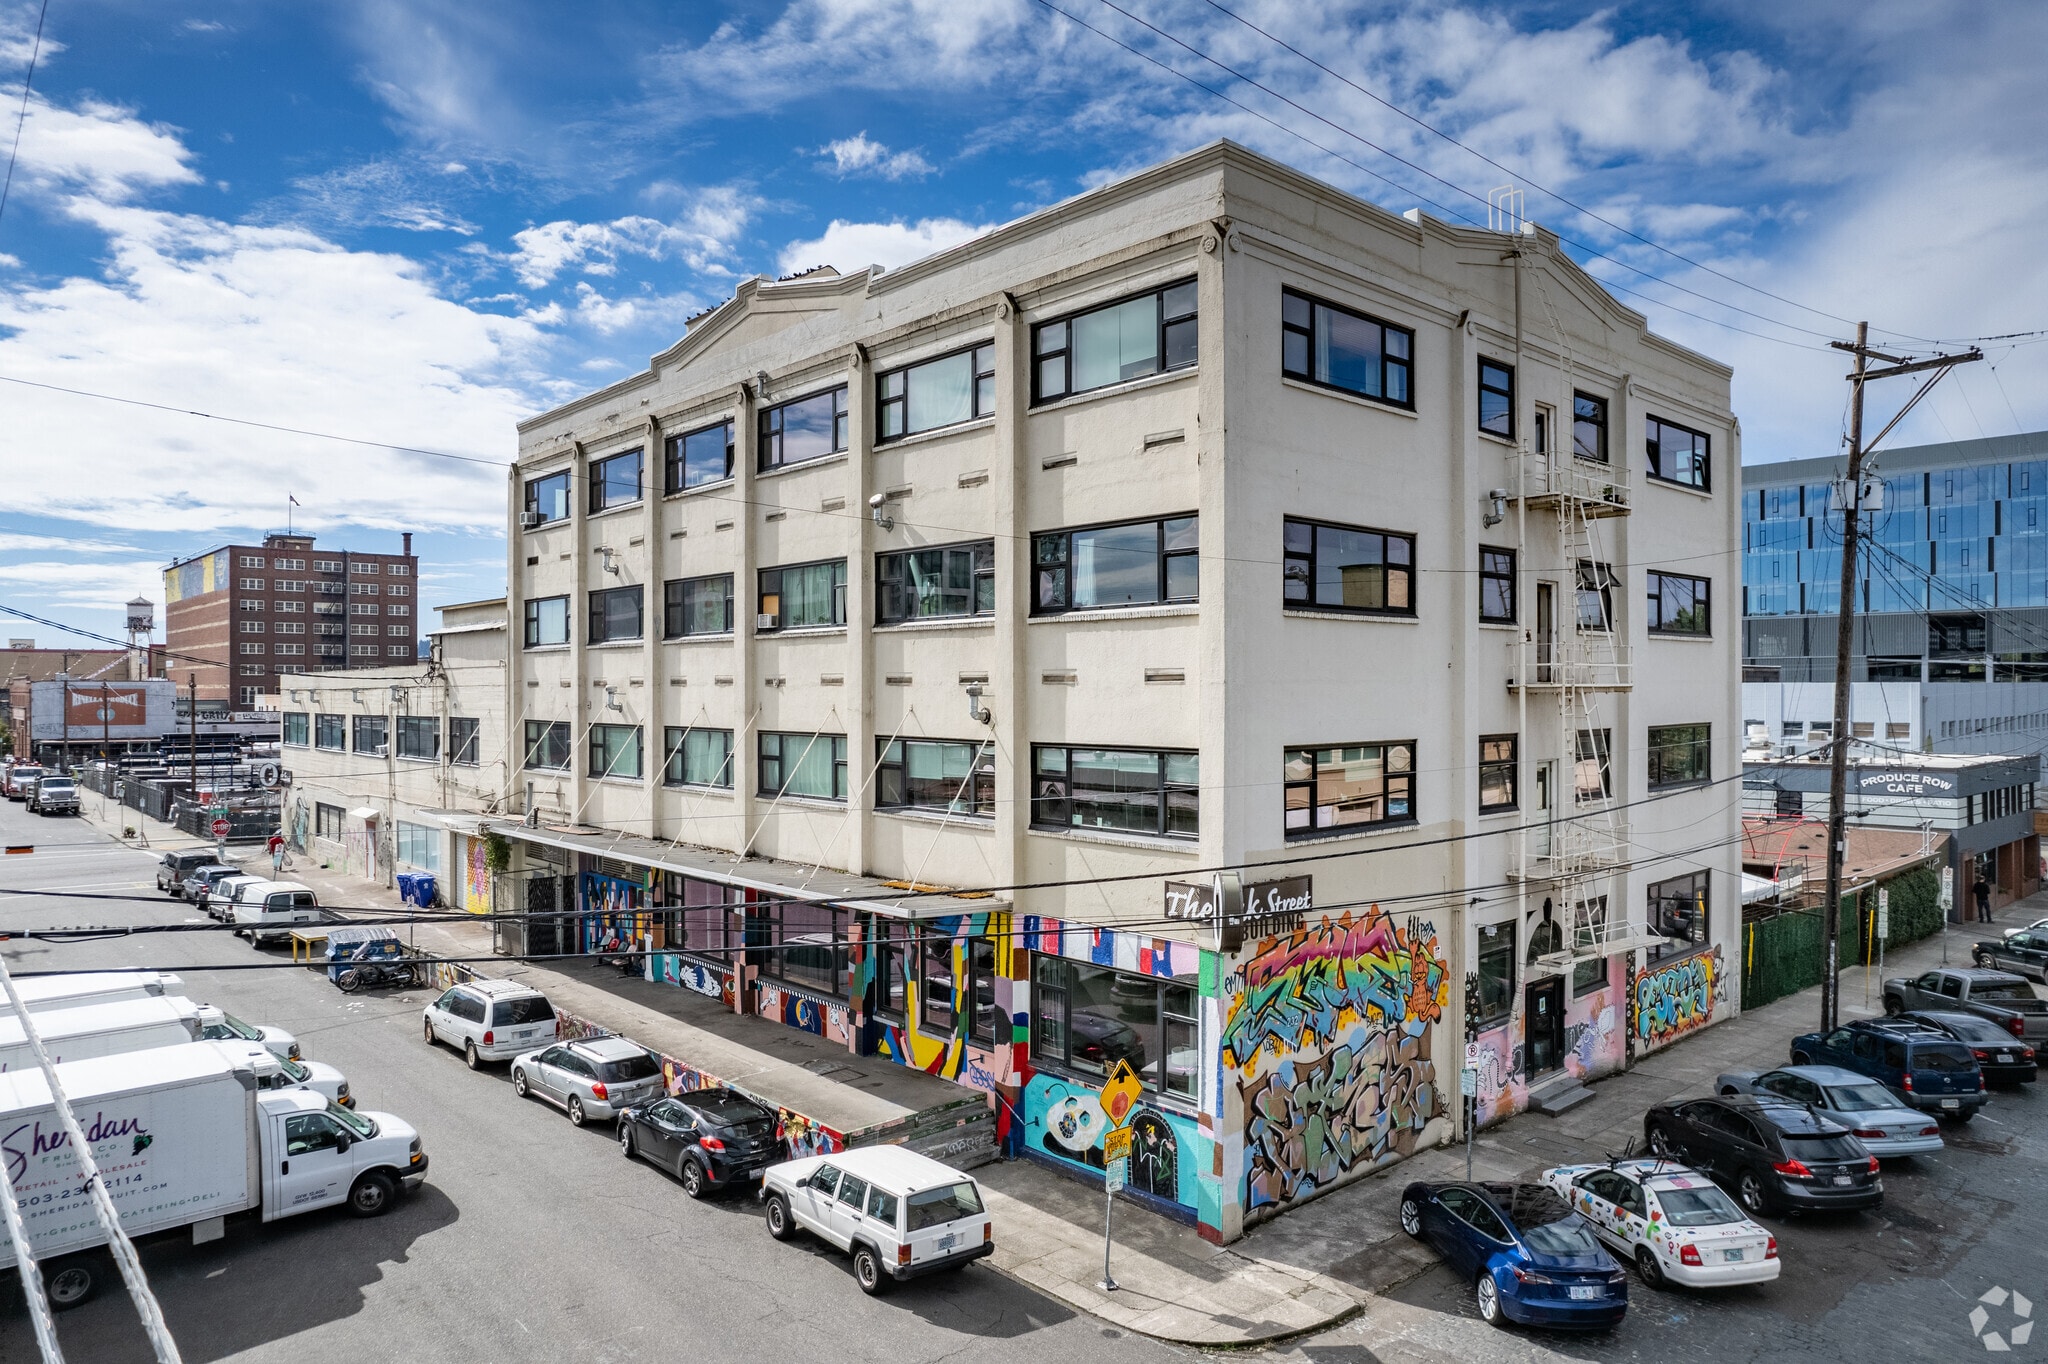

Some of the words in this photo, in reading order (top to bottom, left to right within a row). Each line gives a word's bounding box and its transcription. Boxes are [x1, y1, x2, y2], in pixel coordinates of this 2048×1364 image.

[1860, 774, 1919, 788] PRODUCE
[1922, 775, 1952, 790] ROW
[1887, 783, 1923, 793] CAFE
[1166, 887, 1214, 922] The
[1266, 887, 1312, 917] Street
[15, 1178, 59, 1193] RETAIL
[76, 1160, 148, 1179] WOLESALE
